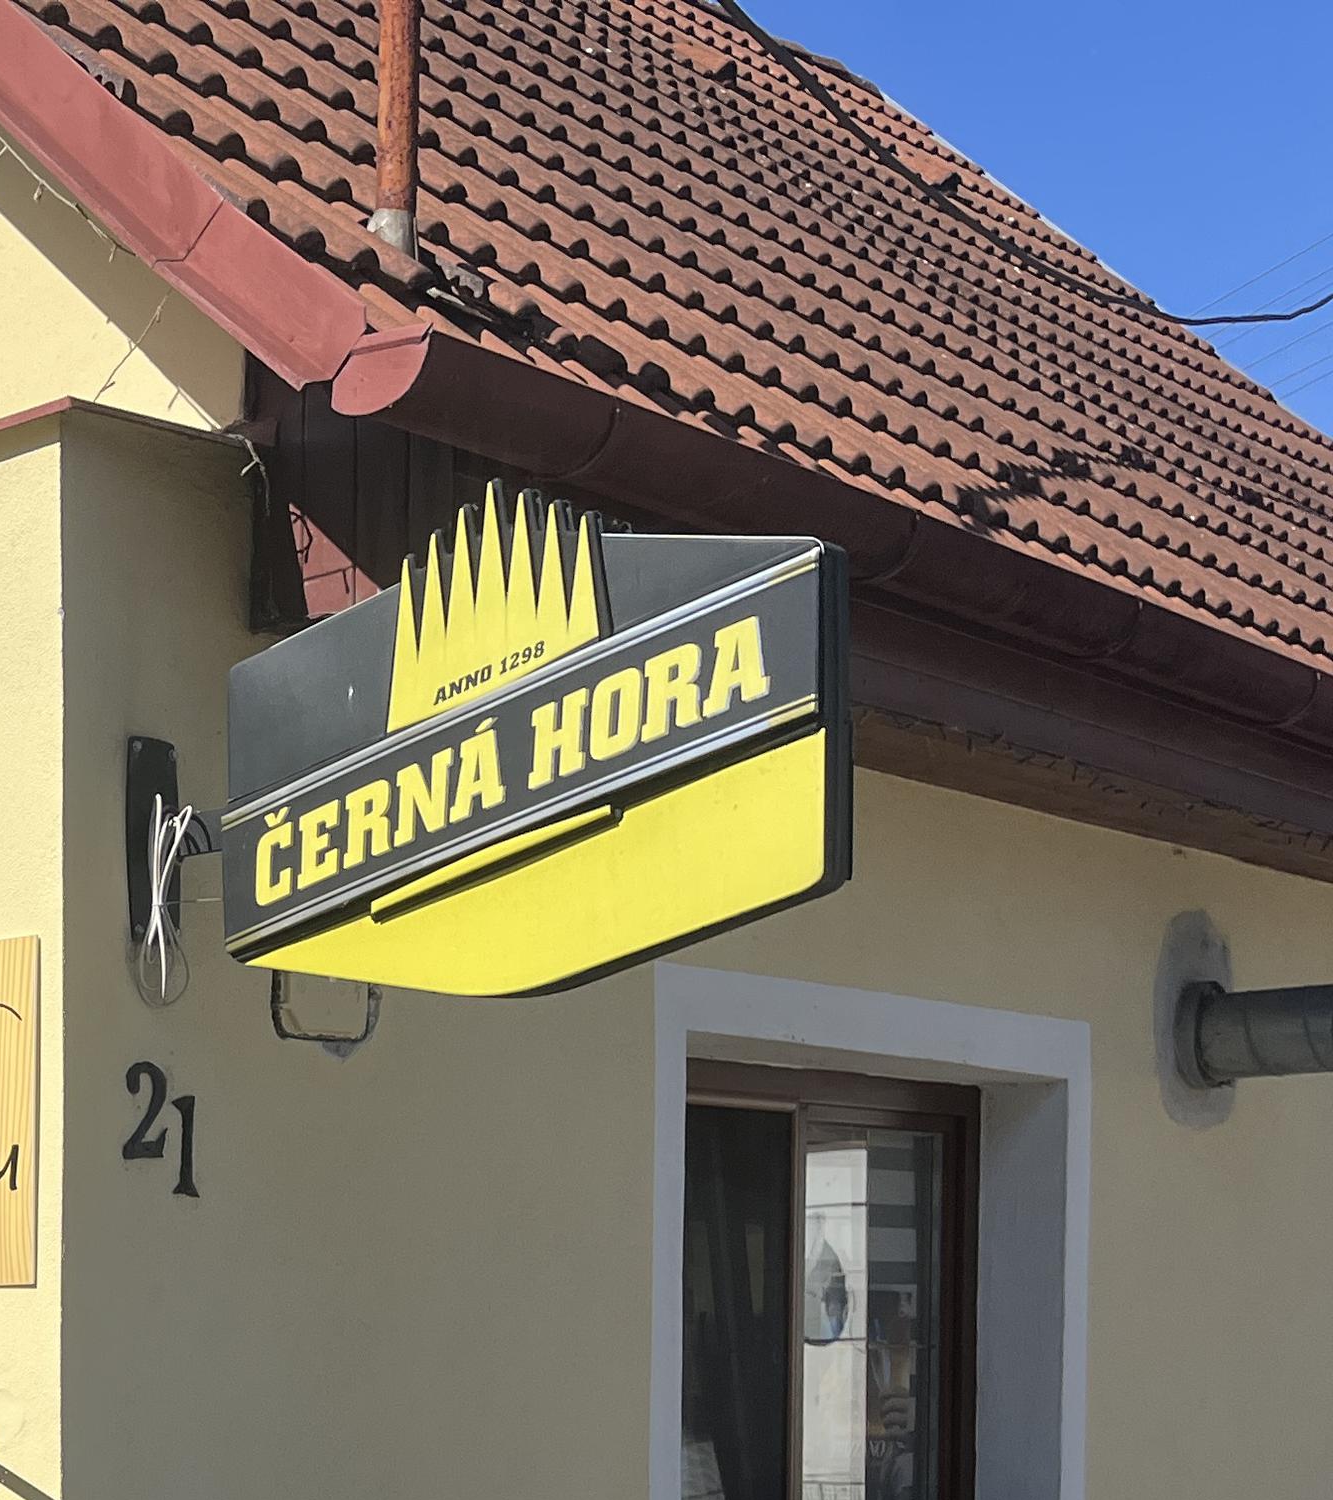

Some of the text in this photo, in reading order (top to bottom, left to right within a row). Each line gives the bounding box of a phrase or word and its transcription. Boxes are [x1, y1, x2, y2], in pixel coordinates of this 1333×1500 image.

[432, 640, 546, 705] ANNO 1298
[254, 614, 770, 907] ČERNÁ HORA
[122, 1060, 201, 1199] 21
